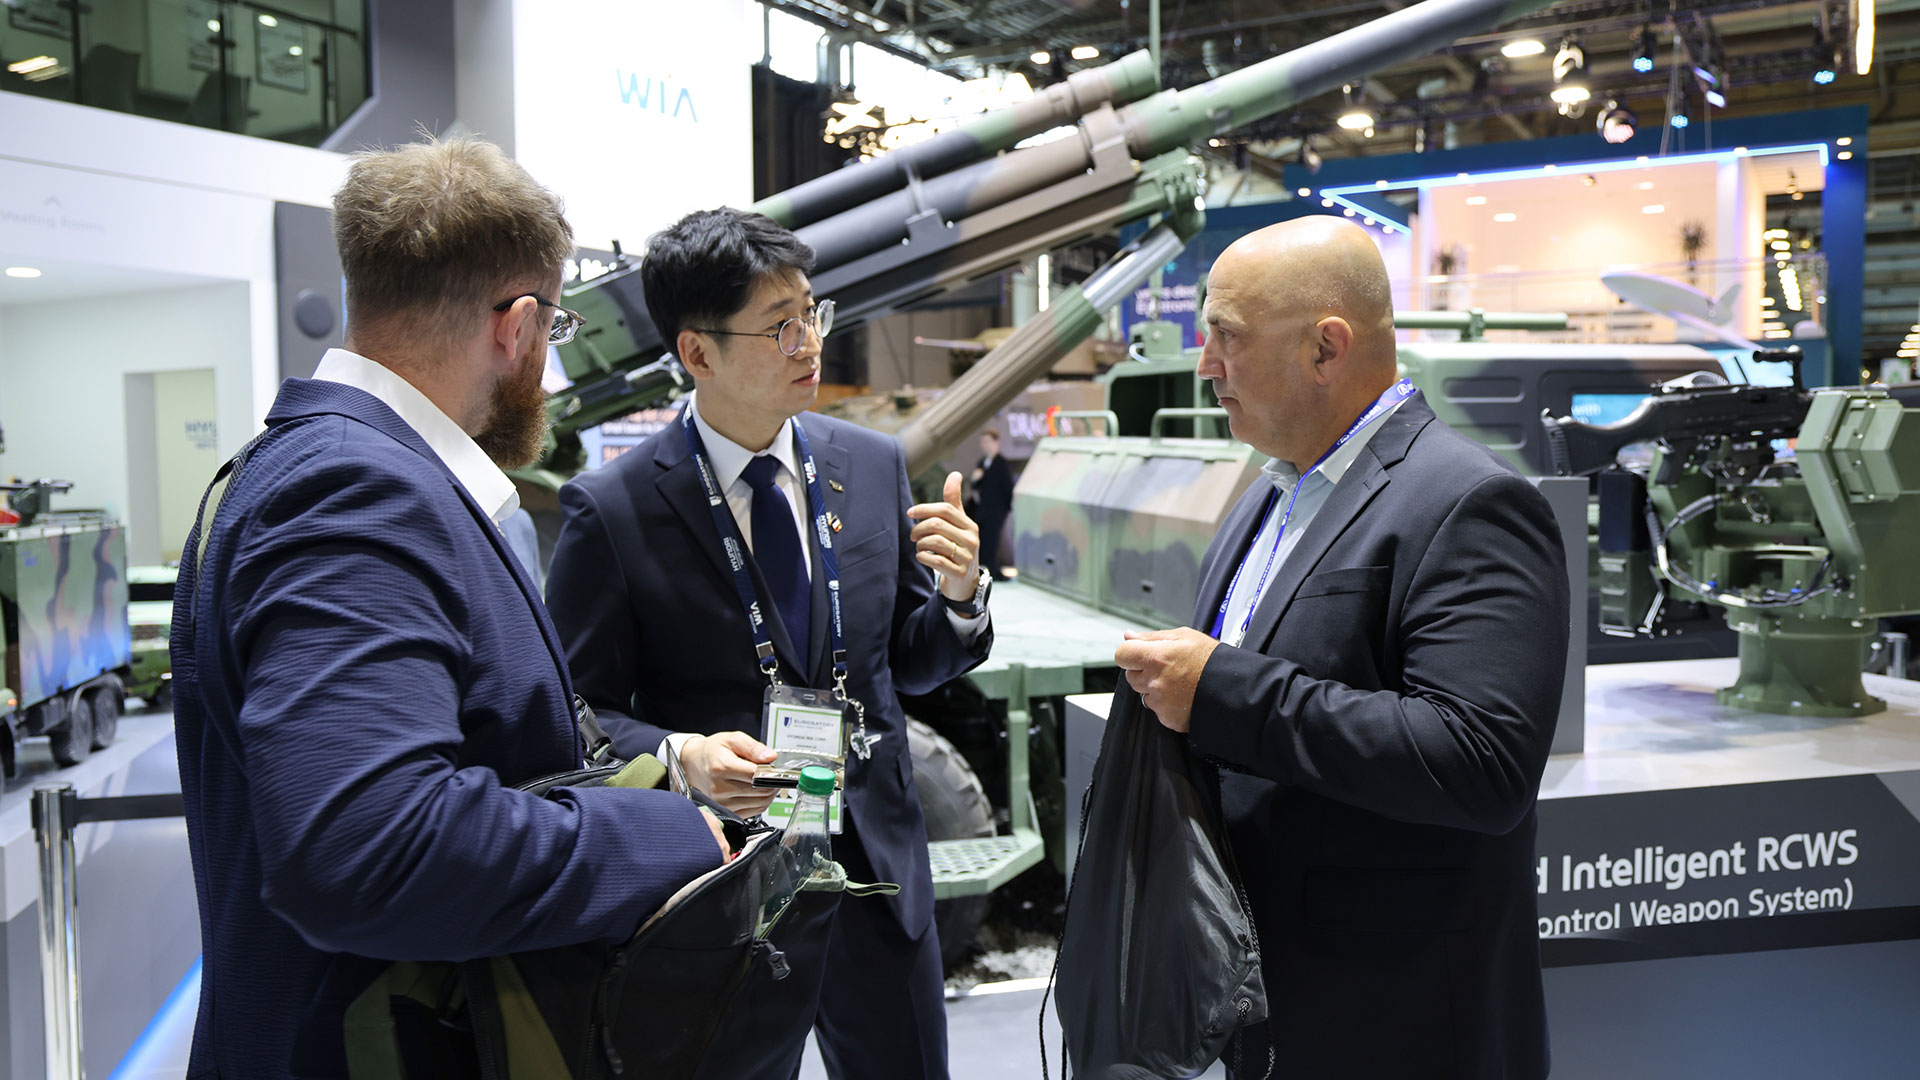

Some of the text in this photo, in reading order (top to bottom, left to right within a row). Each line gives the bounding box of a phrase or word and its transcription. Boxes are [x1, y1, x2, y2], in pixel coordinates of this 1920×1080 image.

[1562, 841, 1746, 890] Intelligent
[1758, 829, 1858, 873] RCWS
[1630, 897, 1739, 927] Weapon
[1749, 878, 1853, 917] System)
